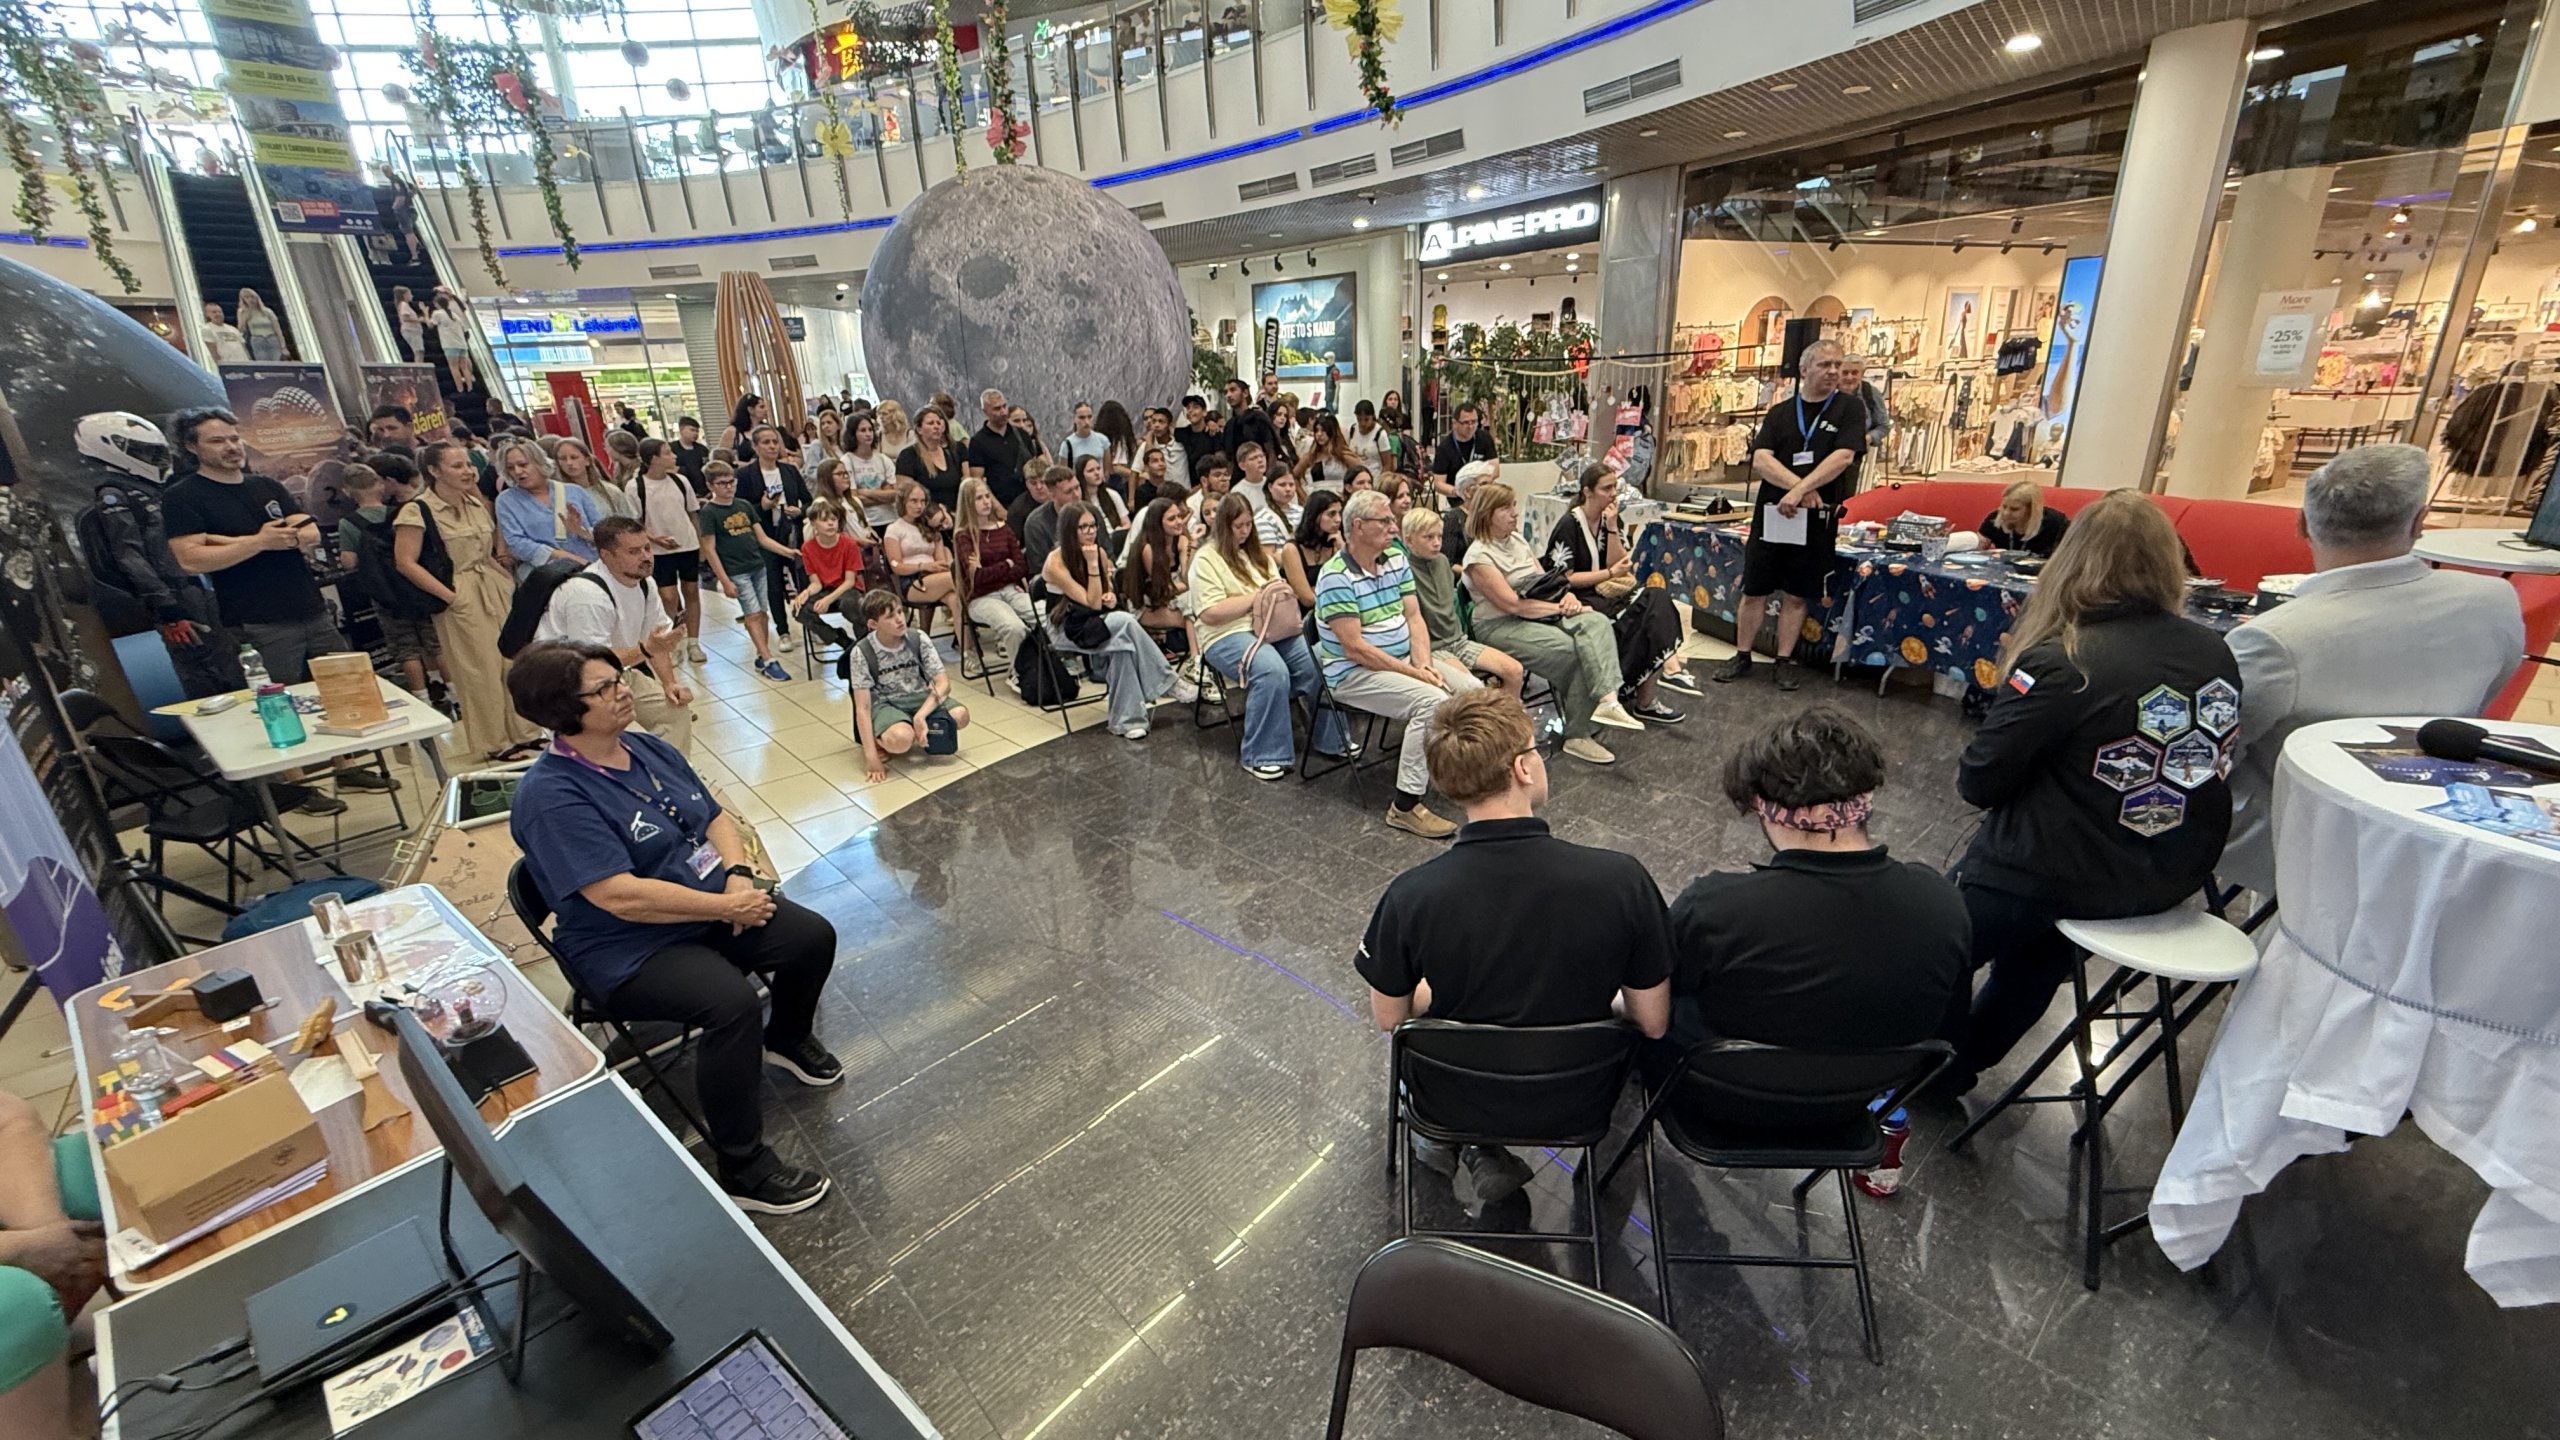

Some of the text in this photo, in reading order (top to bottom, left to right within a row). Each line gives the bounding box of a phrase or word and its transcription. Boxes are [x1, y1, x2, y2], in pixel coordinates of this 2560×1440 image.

[1419, 202, 1599, 262] ALPINE PRO
[501, 318, 553, 334] BENU
[2268, 329, 2304, 343] -25%
[1264, 321, 1278, 375] ÝPREDAJ
[412, 403, 446, 435] dáreň
